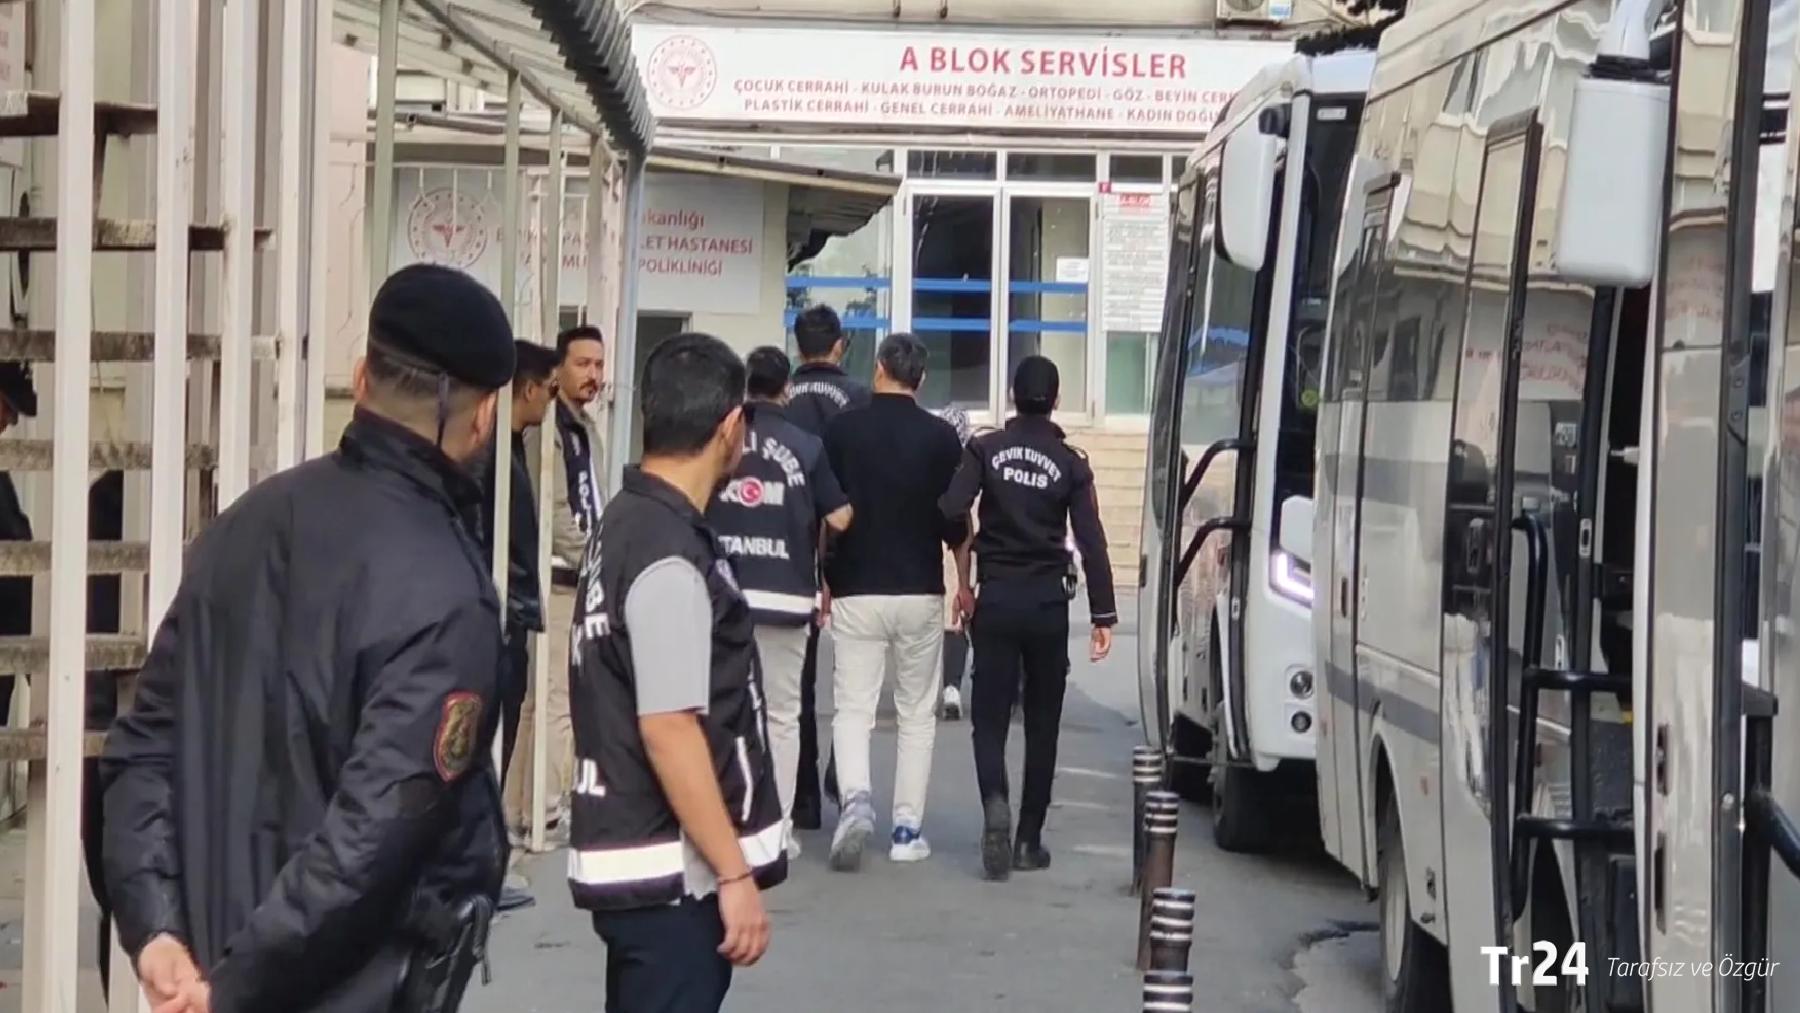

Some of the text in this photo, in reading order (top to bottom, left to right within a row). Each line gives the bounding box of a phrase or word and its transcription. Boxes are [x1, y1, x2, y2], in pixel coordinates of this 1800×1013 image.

[900, 46, 1187, 79] A BLOK SERVİSLER
[734, 79, 786, 94] ÇOCUK
[788, 79, 849, 94] CERRAHİ
[861, 82, 909, 95] KULAK
[913, 83, 962, 97] BURUN
[966, 82, 1017, 97] BOĞAZ
[1112, 87, 1144, 101] GÖZ
[744, 97, 803, 112] PLASTİK
[807, 98, 869, 113] CERRAHİ
[880, 101, 925, 115] GENEL
[930, 101, 993, 116] CERRAHİ
[1127, 108, 1172, 121] KADIN
[642, 207, 704, 231] kanlığı
[667, 235, 753, 254] HASTANESİ
